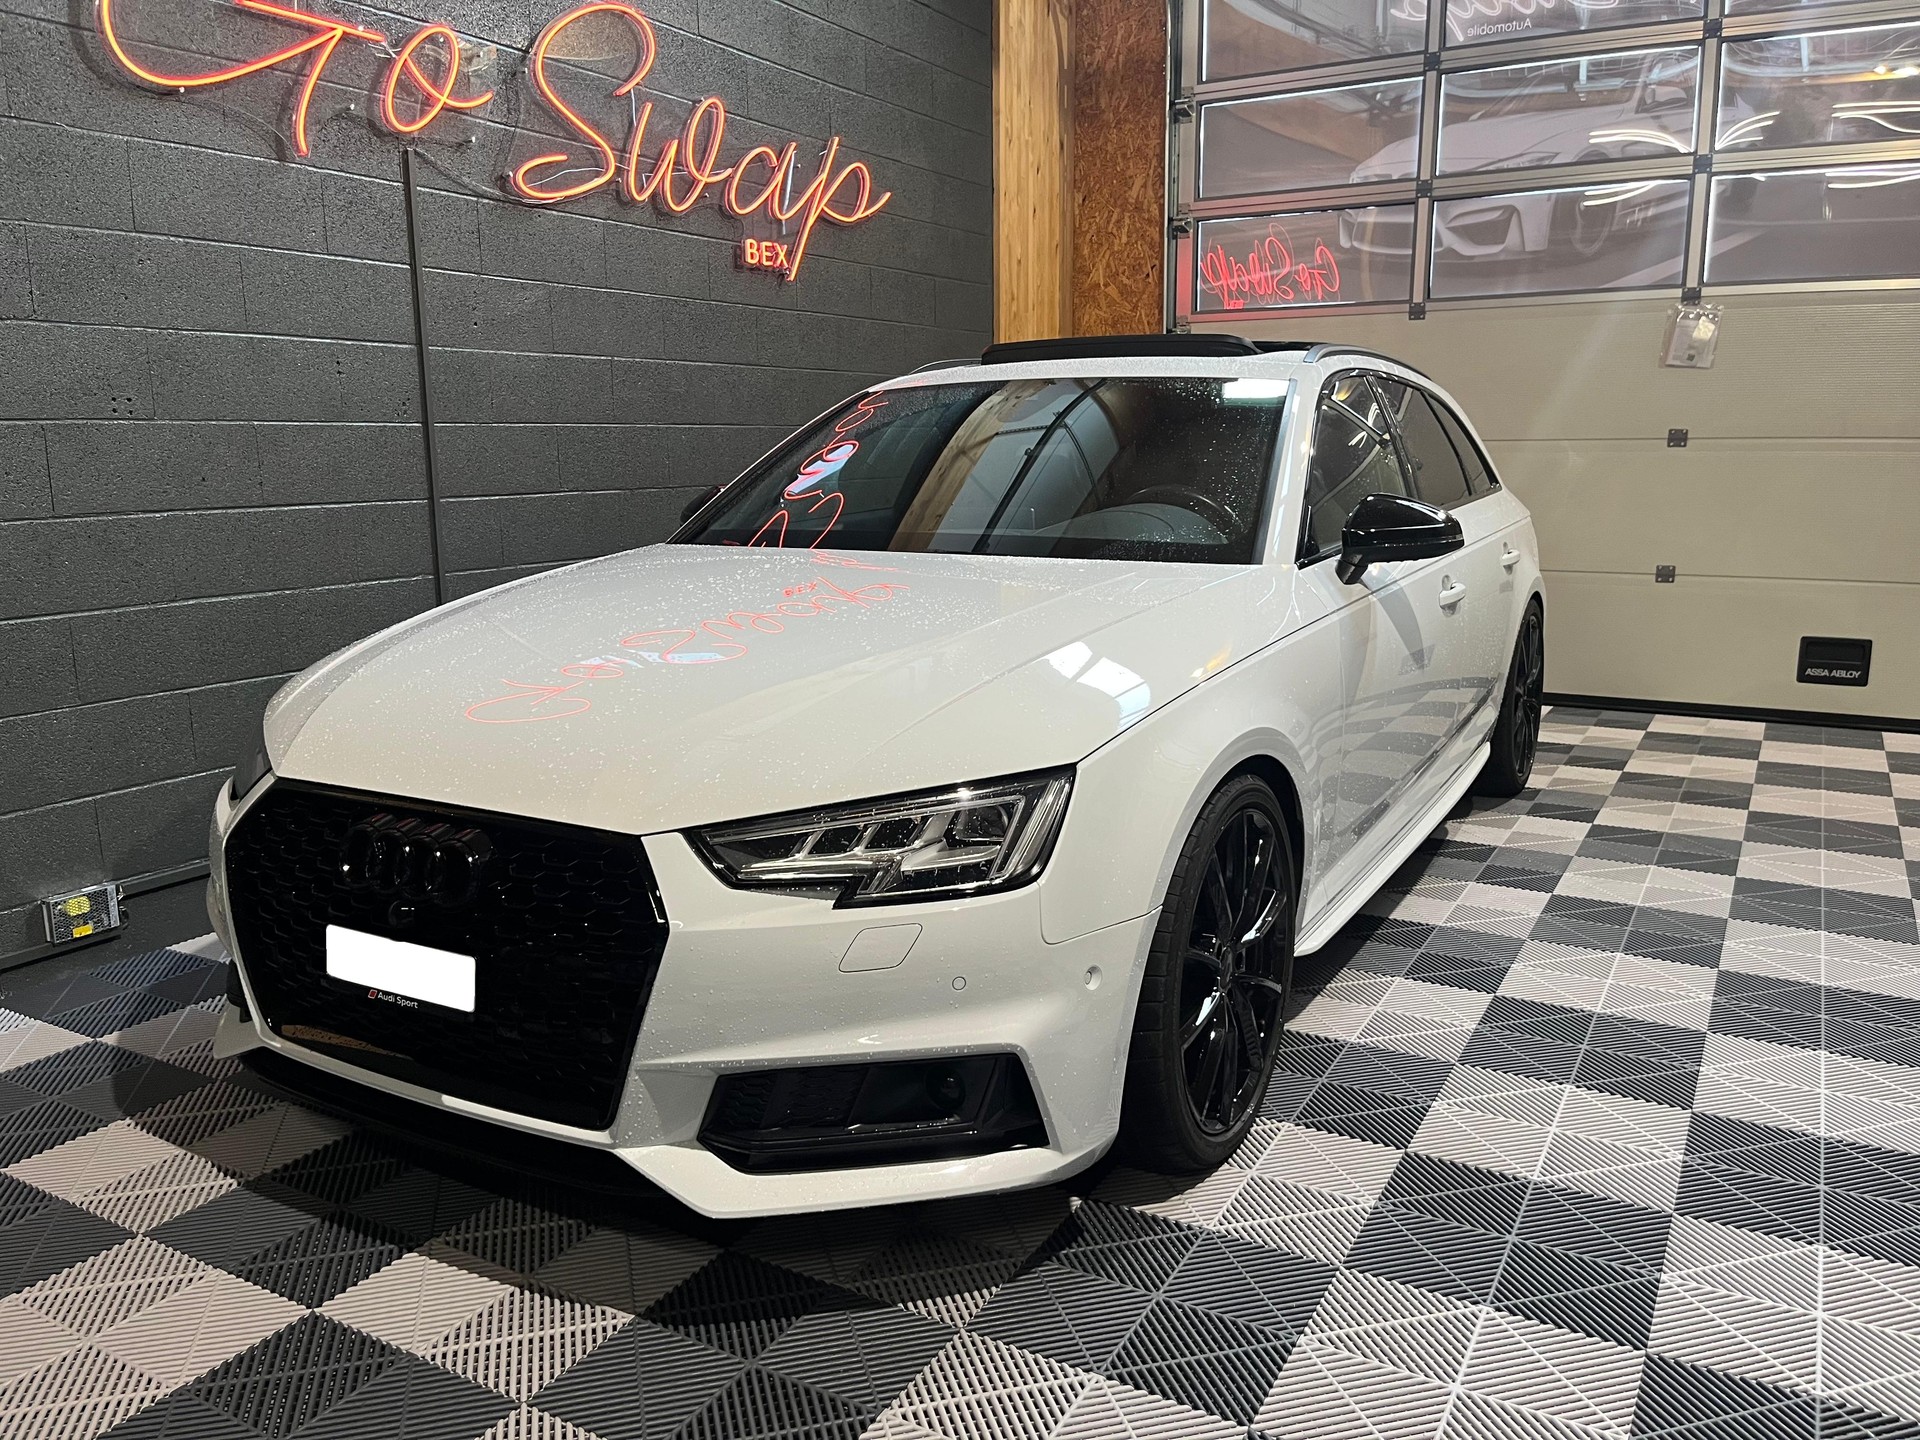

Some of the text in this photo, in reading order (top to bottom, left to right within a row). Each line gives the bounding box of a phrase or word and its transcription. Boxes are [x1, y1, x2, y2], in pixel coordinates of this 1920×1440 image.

[514, 2, 892, 283] Swap
[744, 238, 790, 268] BEX
[1804, 668, 1862, 679] ASSA ABLOY
[377, 991, 419, 1009] Audi Sport
